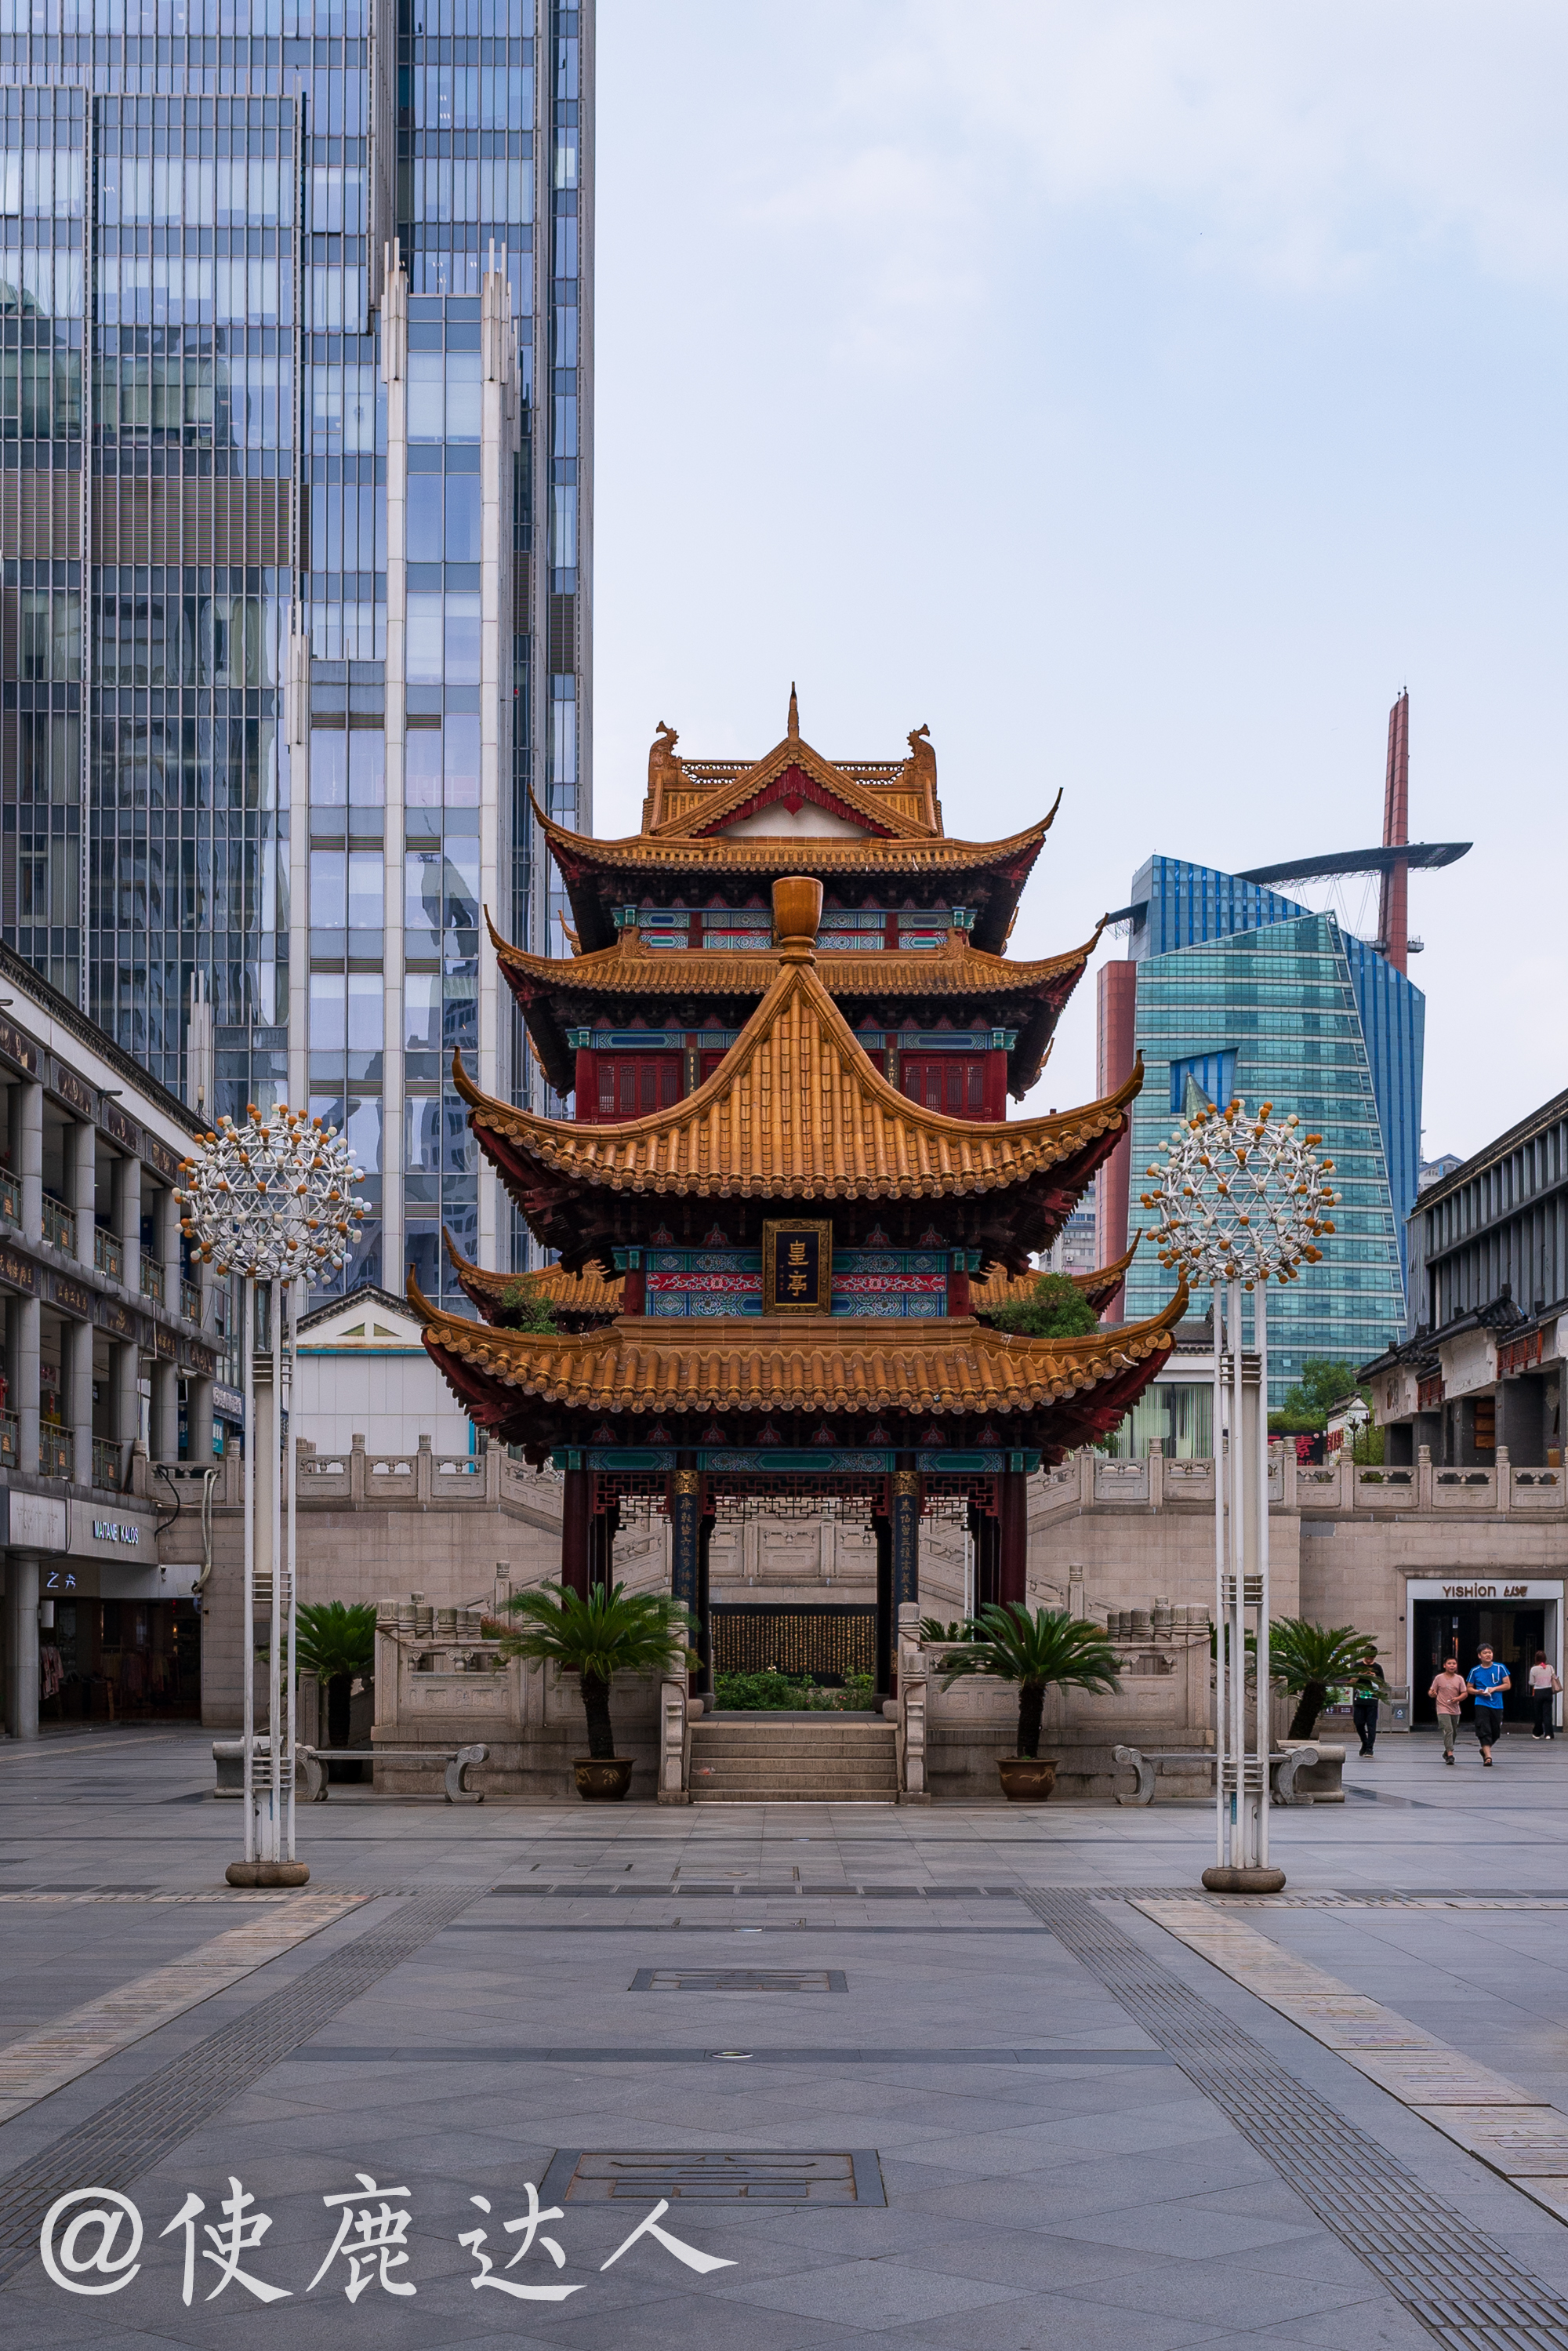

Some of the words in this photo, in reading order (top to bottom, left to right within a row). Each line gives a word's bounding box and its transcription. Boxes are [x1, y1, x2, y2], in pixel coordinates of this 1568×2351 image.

[787, 1240, 810, 1297] 皇亭
[118, 1524, 139, 1545] KALOS
[46, 1571, 76, 1590] 之秀
